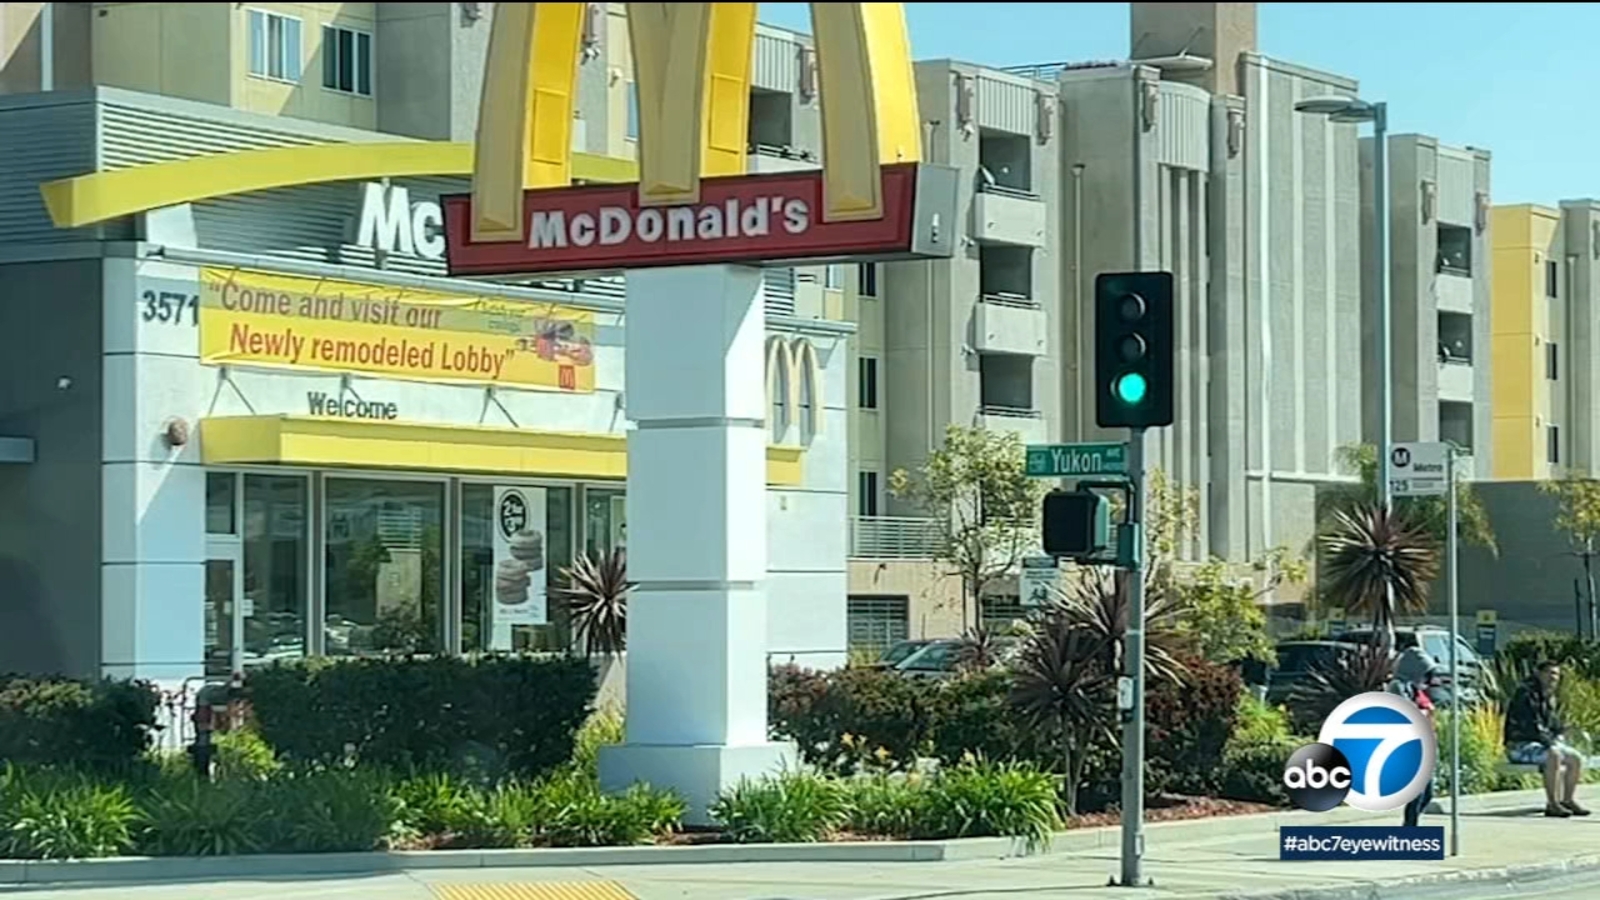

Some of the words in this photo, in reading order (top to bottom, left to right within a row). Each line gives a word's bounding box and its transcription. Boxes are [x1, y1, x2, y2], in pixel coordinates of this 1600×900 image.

[528, 197, 809, 250] McDonald's
[142, 289, 199, 327] 3571
[209, 281, 291, 315] "Come
[299, 293, 343, 320] and
[351, 297, 400, 326] visit
[405, 306, 443, 329] our
[230, 323, 305, 364] Newly
[310, 337, 435, 370] remodeled
[441, 342, 516, 379] Lobby"
[307, 391, 398, 420] Welcome
[1051, 448, 1101, 473] Yukon
